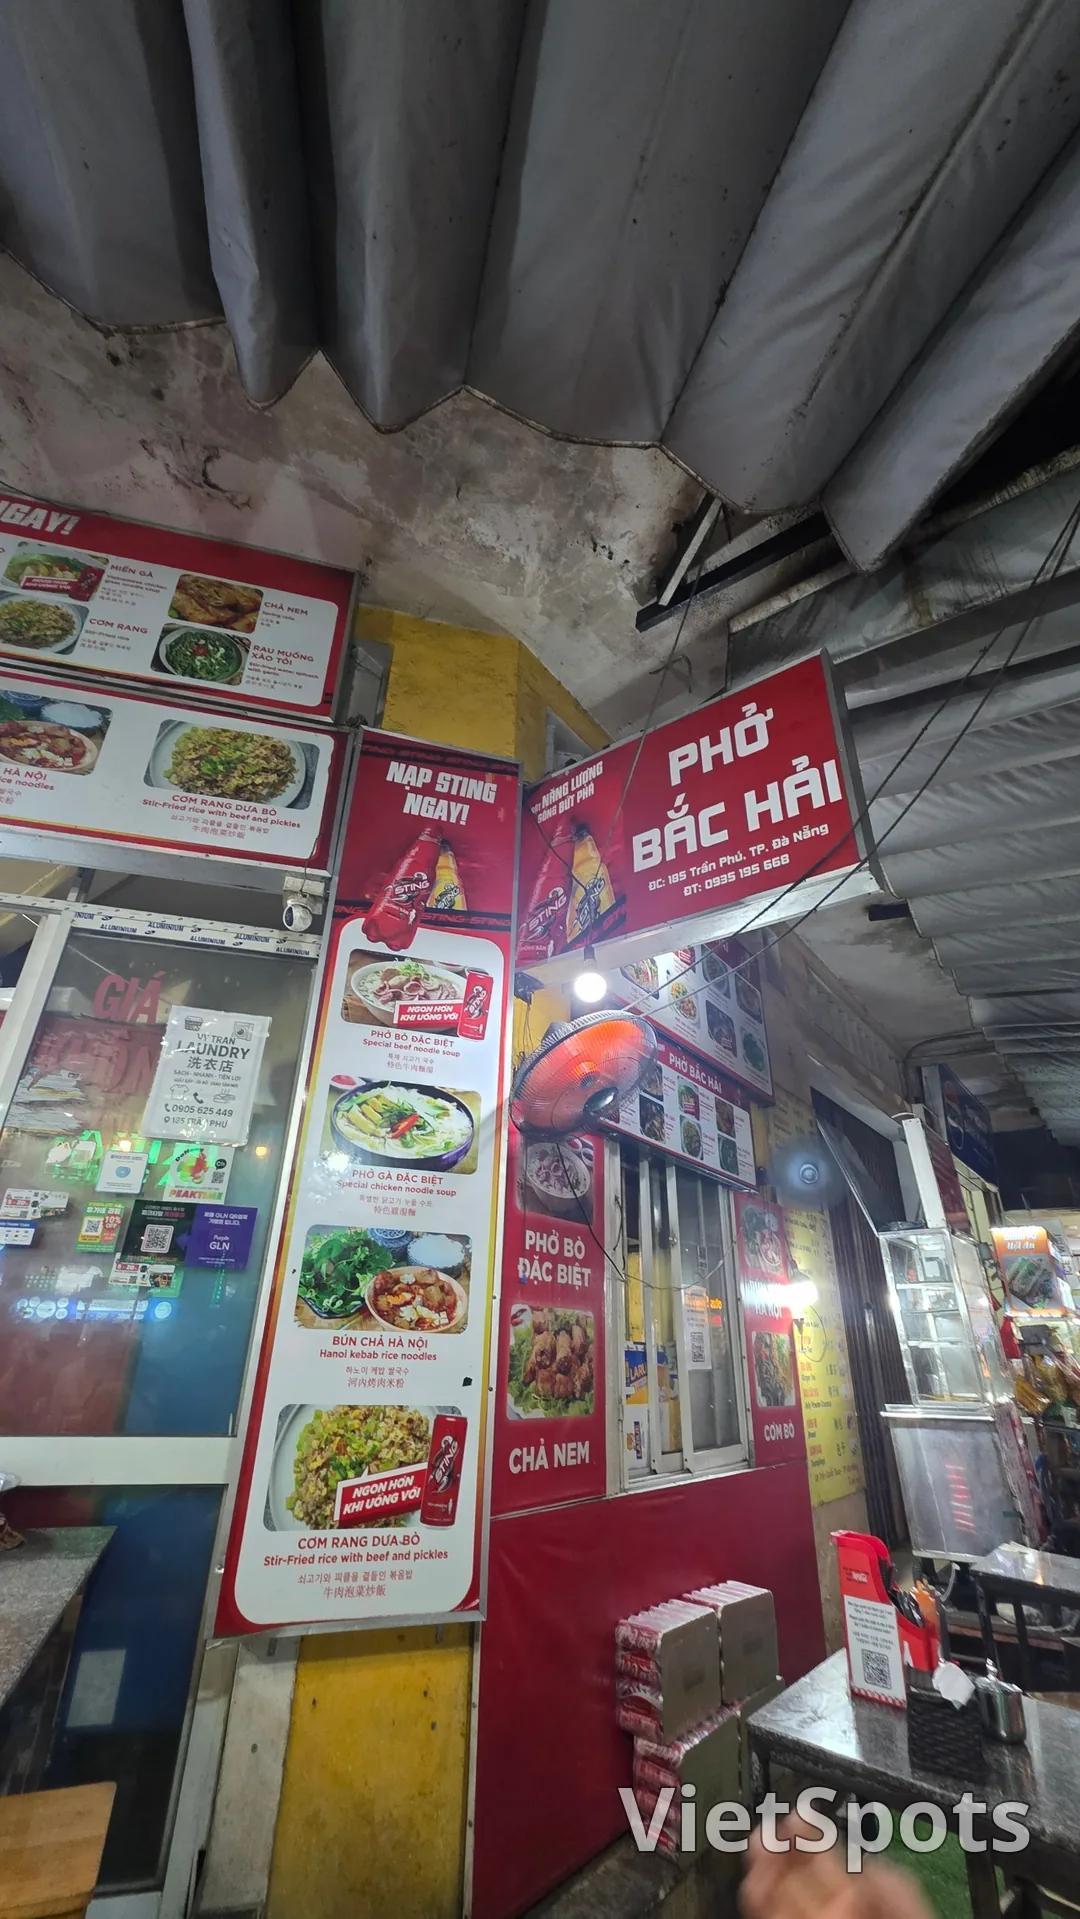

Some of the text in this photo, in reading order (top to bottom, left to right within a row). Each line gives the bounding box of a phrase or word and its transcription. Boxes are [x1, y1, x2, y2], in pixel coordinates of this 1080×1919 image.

[110, 563, 153, 578] MIẾN GÀ
[264, 601, 308, 616] CHẢ NEM
[89, 618, 148, 634] CƠM RANG
[251, 653, 273, 662] XÀO
[253, 645, 274, 654] RAU
[668, 702, 774, 787] PHỞ
[3, 766, 47, 782] HÀ NỘI
[15, 780, 54, 791] noodles
[386, 761, 498, 804] NẠP STING
[542, 781, 569, 809] NĂNG
[172, 794, 277, 816] CƠM RANG DƯA BÒ
[403, 792, 470, 825] NGAY!
[142, 799, 301, 829] Stir-Fried rice with beef and pickles
[631, 755, 843, 873] BẮC HẢI
[648, 823, 830, 891] ĐC: 185 Trần TP. Đà Nẵng
[683, 854, 790, 897] ĐT: 0935 195 668
[394, 880, 430, 895] STING
[529, 894, 567, 931] STING
[100, 923, 137, 934] ALUMINIUM
[147, 921, 184, 932] ALUMINIUM
[189, 935, 226, 945] ALUMINIUM
[235, 932, 270, 943] ALUMINIUM
[275, 946, 310, 956] ALUMINIUM
[93, 970, 167, 1025] GIÁ
[406, 1005, 454, 1013] NGON HƠN
[400, 1013, 417, 1022] KHI
[211, 1034, 236, 1045] TRAN
[371, 1029, 454, 1049] PHỞ BÒ ĐẶC BIỆT
[177, 1040, 250, 1060] LAUNDRY
[363, 1038, 461, 1058] Special beef noodle soup
[187, 1056, 234, 1073] 洗衣店
[669, 1053, 722, 1094] PHỞ BẮC HẢI
[171, 1104, 234, 1118] 0905 625 449
[209, 1119, 228, 1128] PHÚ
[352, 1168, 444, 1188] PHỞ GÀ ĐẶC BIỆT
[168, 1189, 223, 1200] PEAKTIME
[336, 1179, 457, 1198] Special chicken noodle soup
[104, 1215, 122, 1224] 10%
[209, 1241, 230, 1251] GLN
[213, 1234, 230, 1242] Purple
[525, 1229, 586, 1260] PHỞ BÒ
[517, 1258, 592, 1291] ĐẶC BIỆT
[332, 1334, 428, 1350] BÚN CHẢ HÀ NỘI
[319, 1349, 437, 1361] Hanoi kebab rice noodles
[345, 1366, 368, 1376] 하노이
[388, 1366, 410, 1376] 쌀국수
[764, 1419, 796, 1442] CƠM BÒ
[434, 1440, 459, 1483] STING
[508, 1437, 591, 1475] CHẢ NEM
[352, 1475, 414, 1499] NGON HƠN
[343, 1487, 421, 1515] KHI UỐNG VỚI
[298, 1531, 420, 1550] CƠM RANG DƯA BÒ
[264, 1549, 448, 1566] Stir-Fried rice with beef and pickles
[298, 1573, 331, 1585] 쇠고기와
[389, 1569, 413, 1580] 볶음밥
[323, 1584, 386, 1599] 牛肉泡菜炒飯
